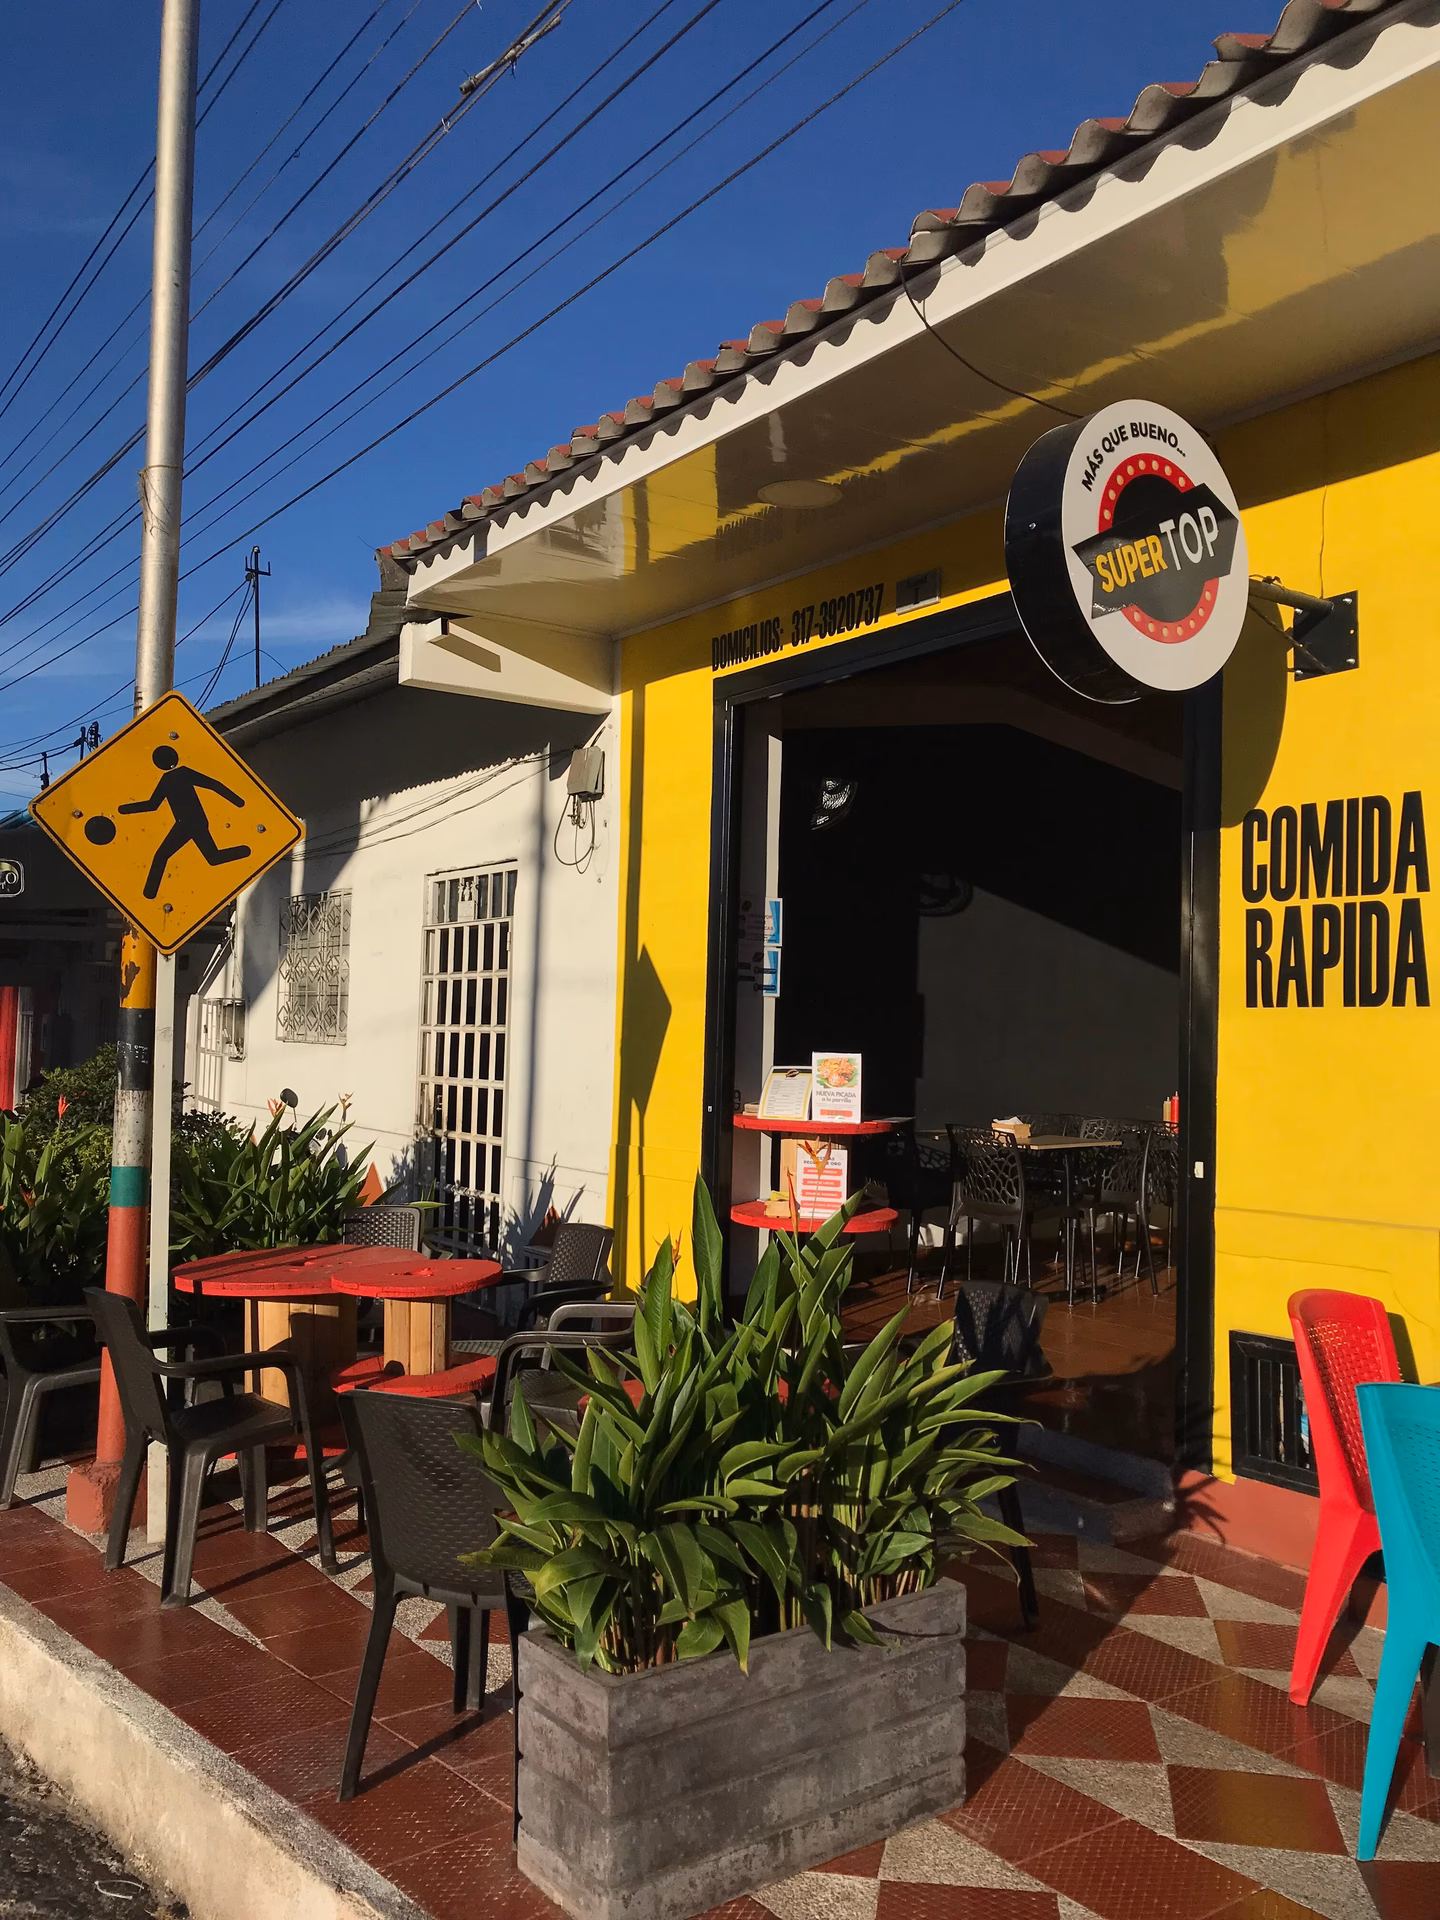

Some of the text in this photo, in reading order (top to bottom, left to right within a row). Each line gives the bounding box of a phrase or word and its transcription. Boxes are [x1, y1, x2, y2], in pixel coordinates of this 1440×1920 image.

[1081, 448, 1104, 492] MÁS
[1101, 424, 1129, 454] QUE
[1095, 506, 1219, 593] SUPER TOP
[791, 582, 885, 648] 317-3920737
[1241, 790, 1431, 904] COMIDA
[1245, 898, 1431, 1008] RAPIDA
